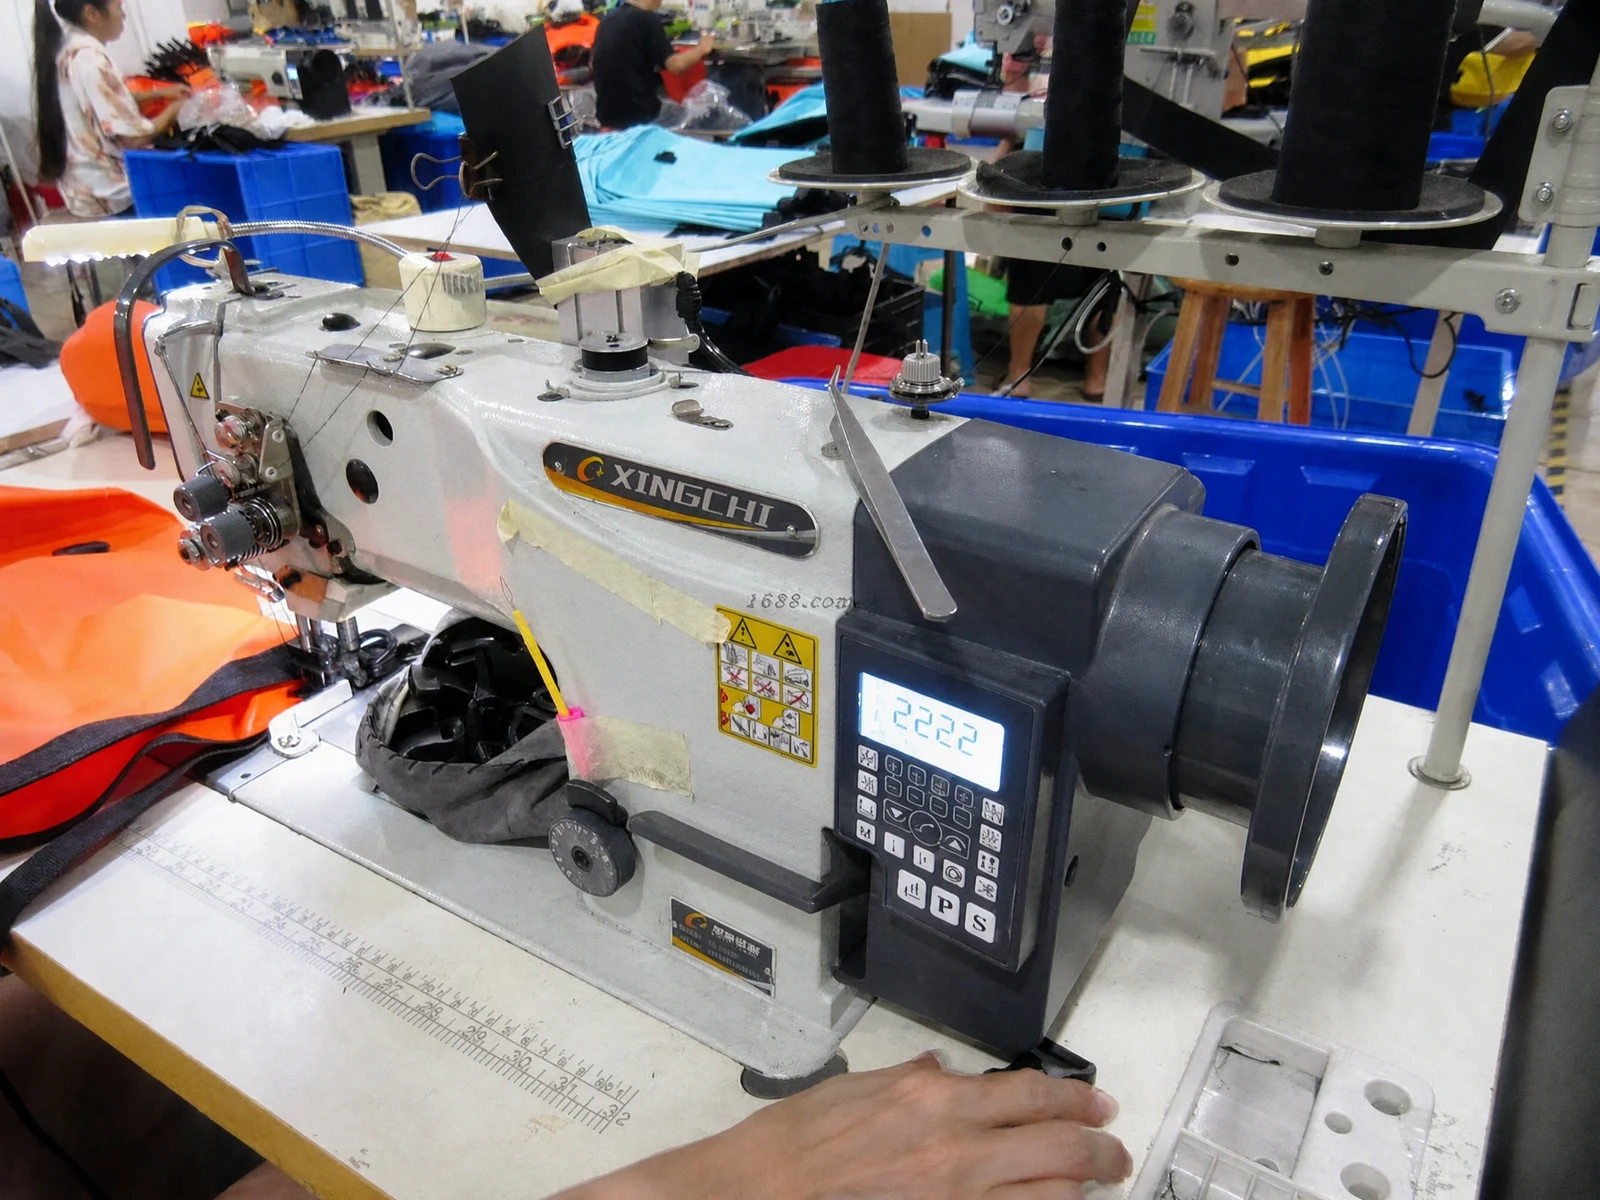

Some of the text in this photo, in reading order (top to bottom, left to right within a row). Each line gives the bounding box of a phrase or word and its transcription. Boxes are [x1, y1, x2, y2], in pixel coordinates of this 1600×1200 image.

[610, 464, 774, 528] XINGCHI
[893, 697, 977, 756] 2222
[937, 896, 954, 914] P
[972, 914, 987, 932] S
